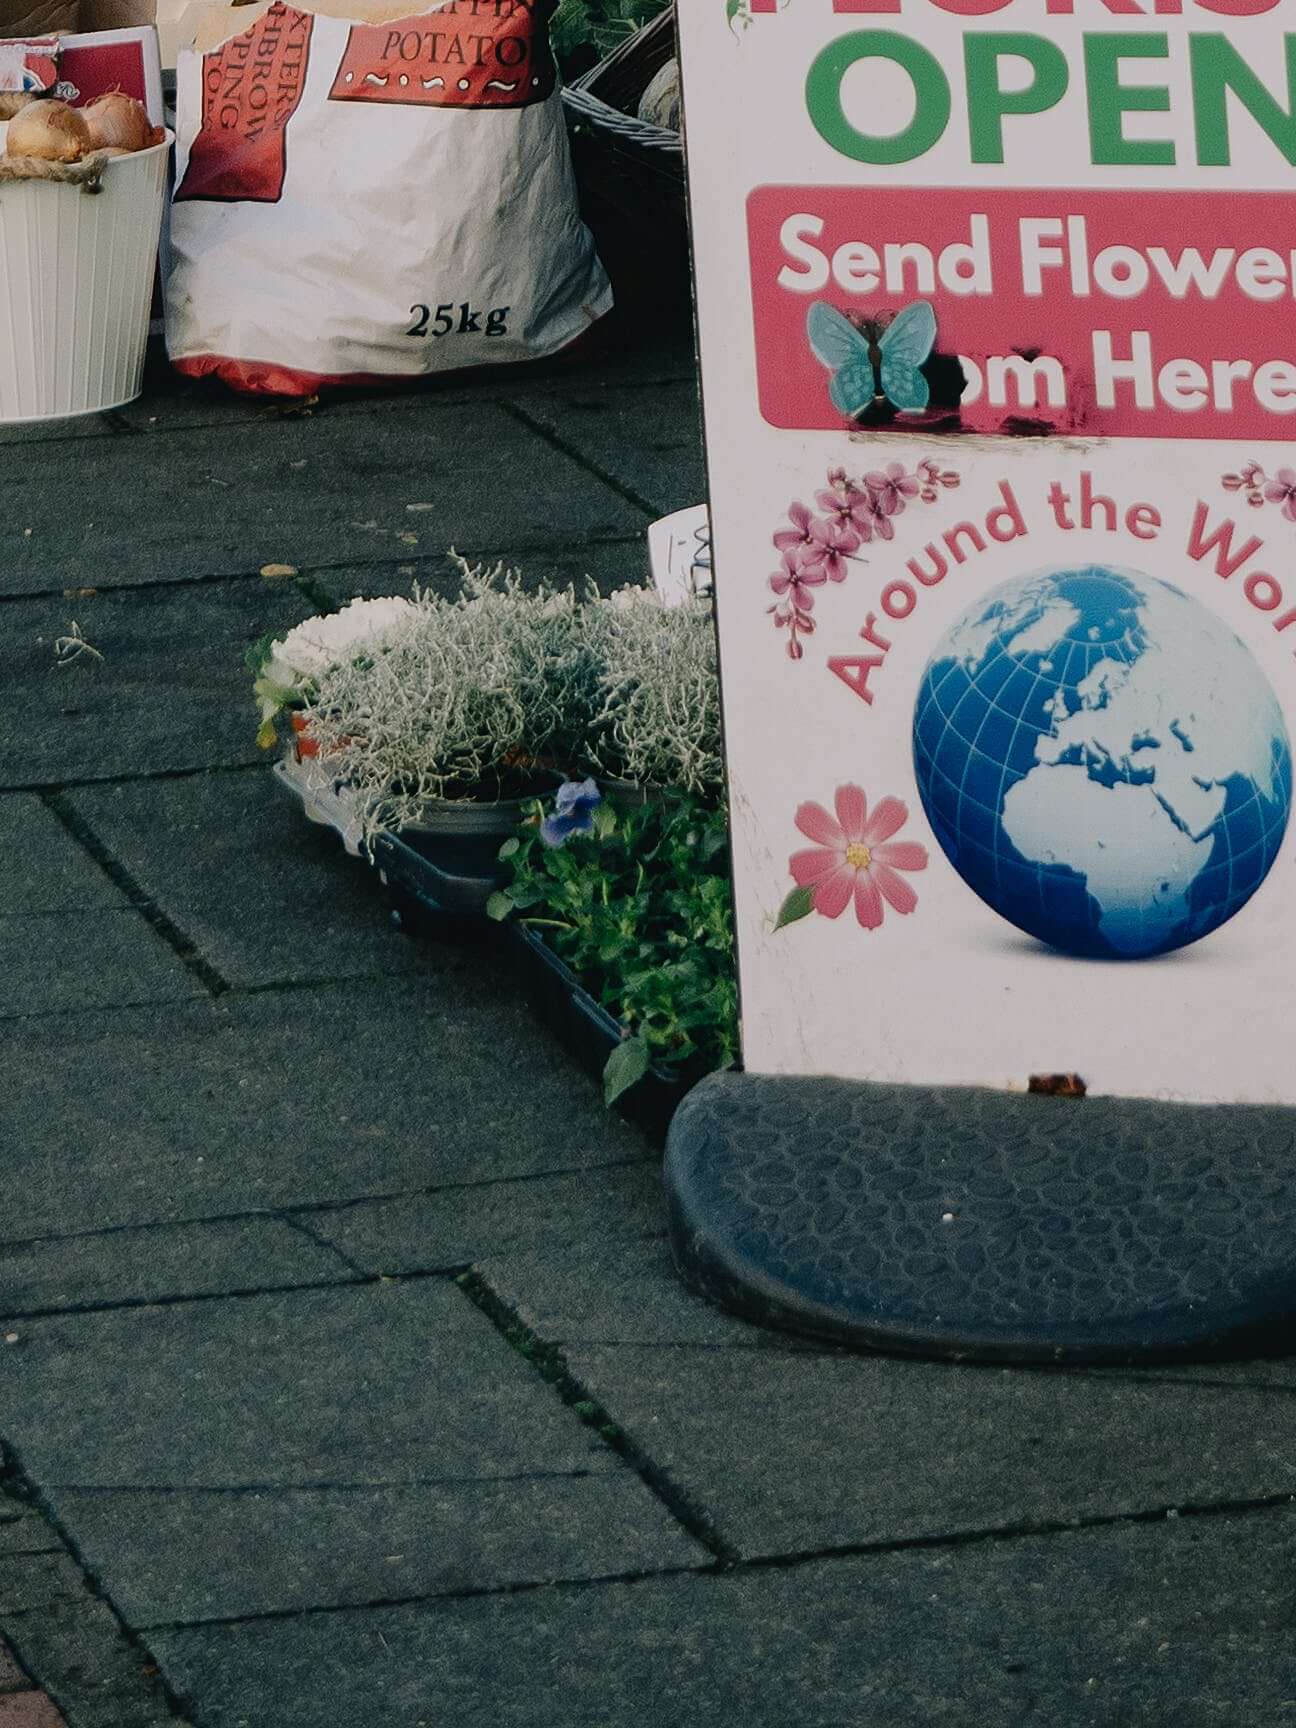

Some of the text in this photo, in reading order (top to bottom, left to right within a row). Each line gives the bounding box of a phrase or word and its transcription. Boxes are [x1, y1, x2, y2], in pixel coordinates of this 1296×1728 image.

[380, 30, 528, 66] POTATO
[777, 212, 994, 297] Send
[405, 301, 511, 338] 25kg
[960, 348, 1067, 411] om
[825, 479, 1029, 707] Around
[1046, 470, 1163, 540] the
